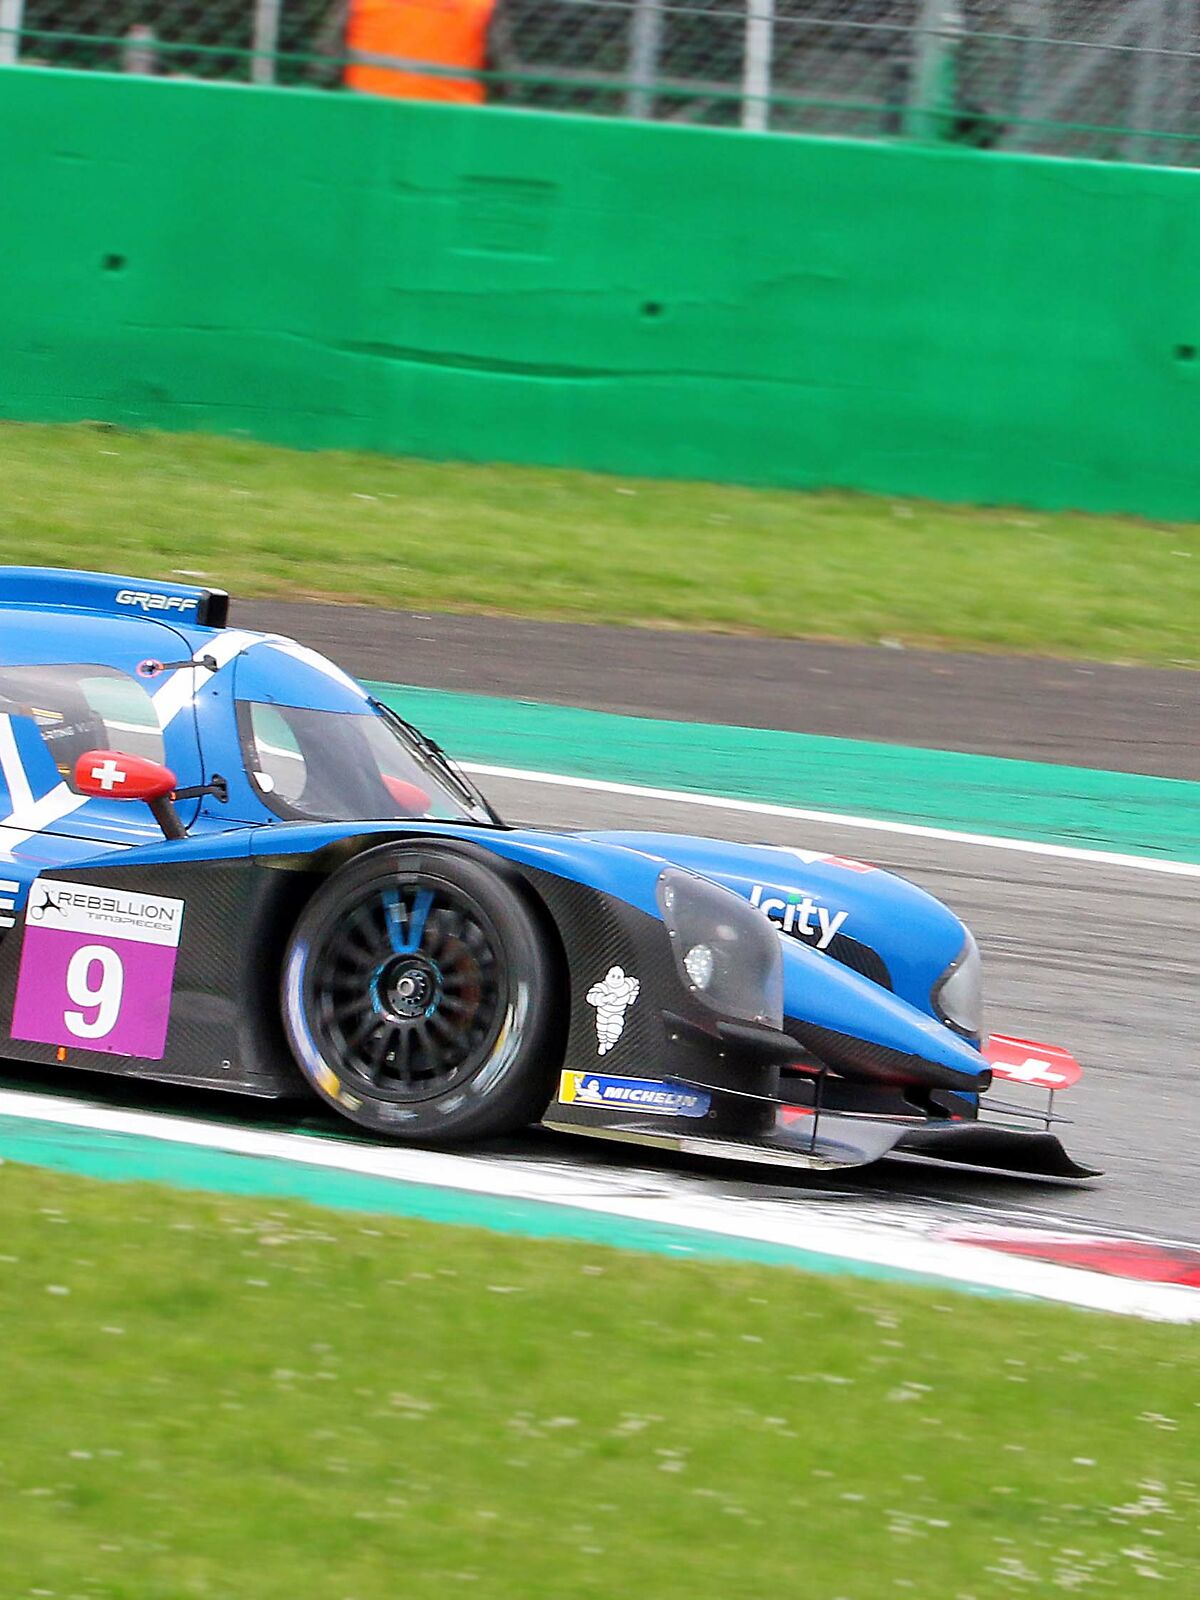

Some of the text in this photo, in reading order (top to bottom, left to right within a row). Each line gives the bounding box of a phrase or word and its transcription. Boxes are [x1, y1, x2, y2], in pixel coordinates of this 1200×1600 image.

[115, 589, 199, 612] GRAFF
[58, 892, 175, 921] REBELLION
[750, 885, 849, 949] lcity
[64, 944, 124, 1039] 9
[604, 1086, 698, 1107] MICHELIN
